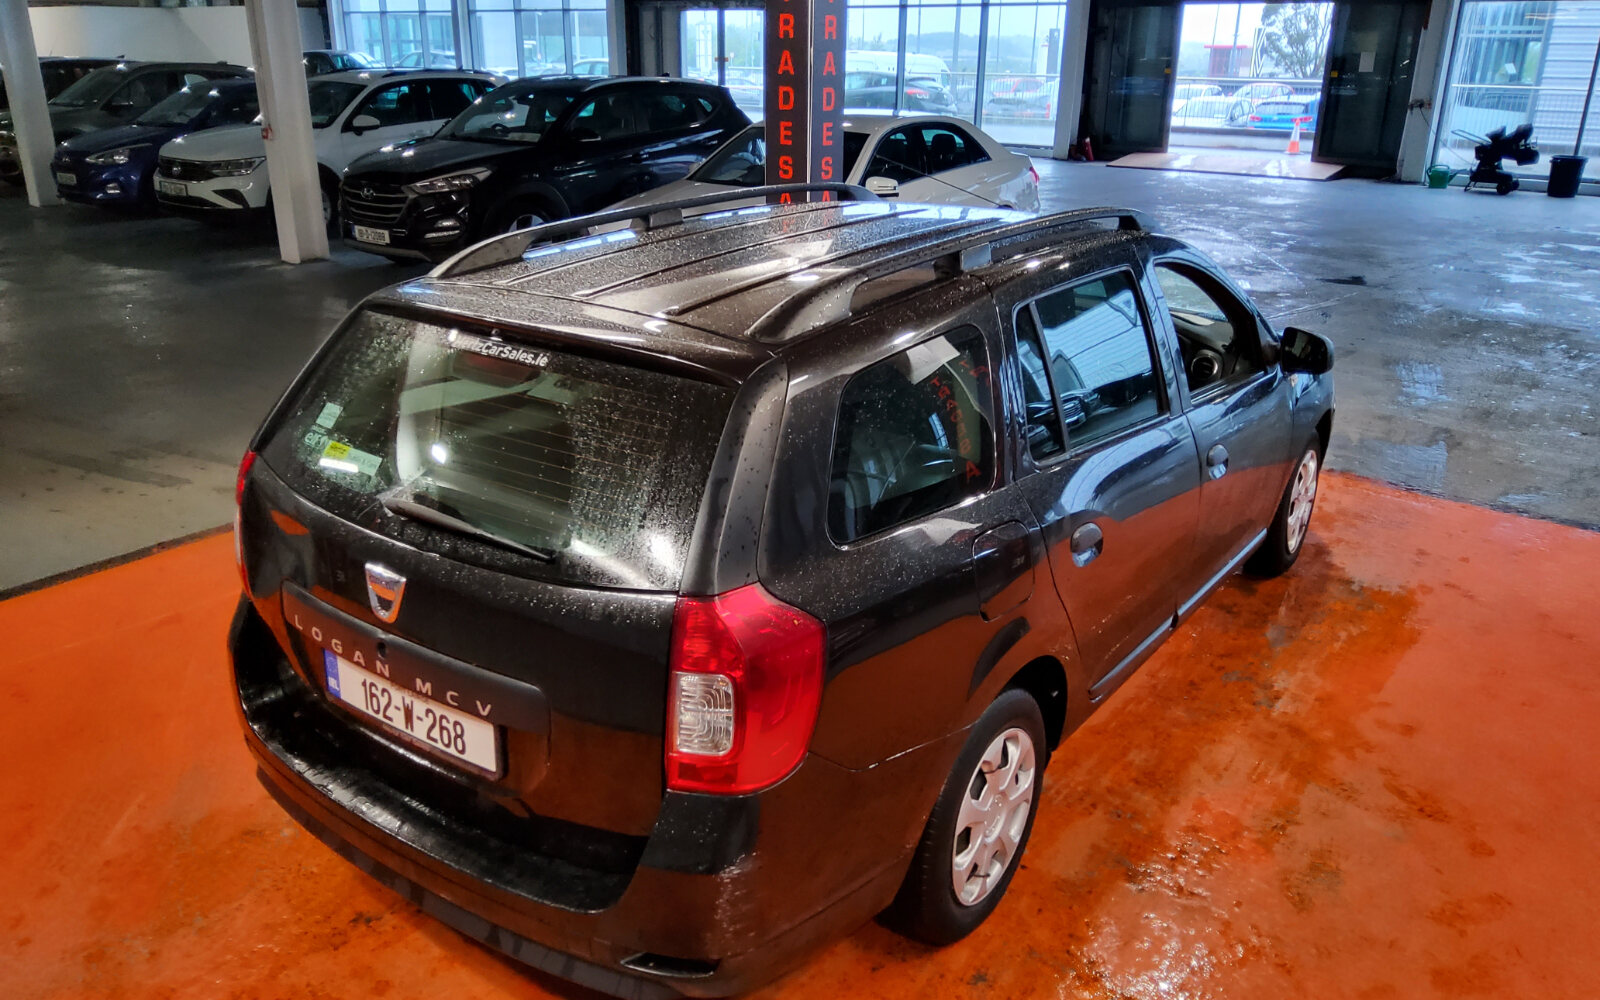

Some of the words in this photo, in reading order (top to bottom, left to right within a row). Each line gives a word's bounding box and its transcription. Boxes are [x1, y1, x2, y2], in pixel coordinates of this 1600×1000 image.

[294, 614, 390, 678] LOGAN
[415, 677, 492, 717] MCV
[361, 678, 466, 756] 162-W-268
